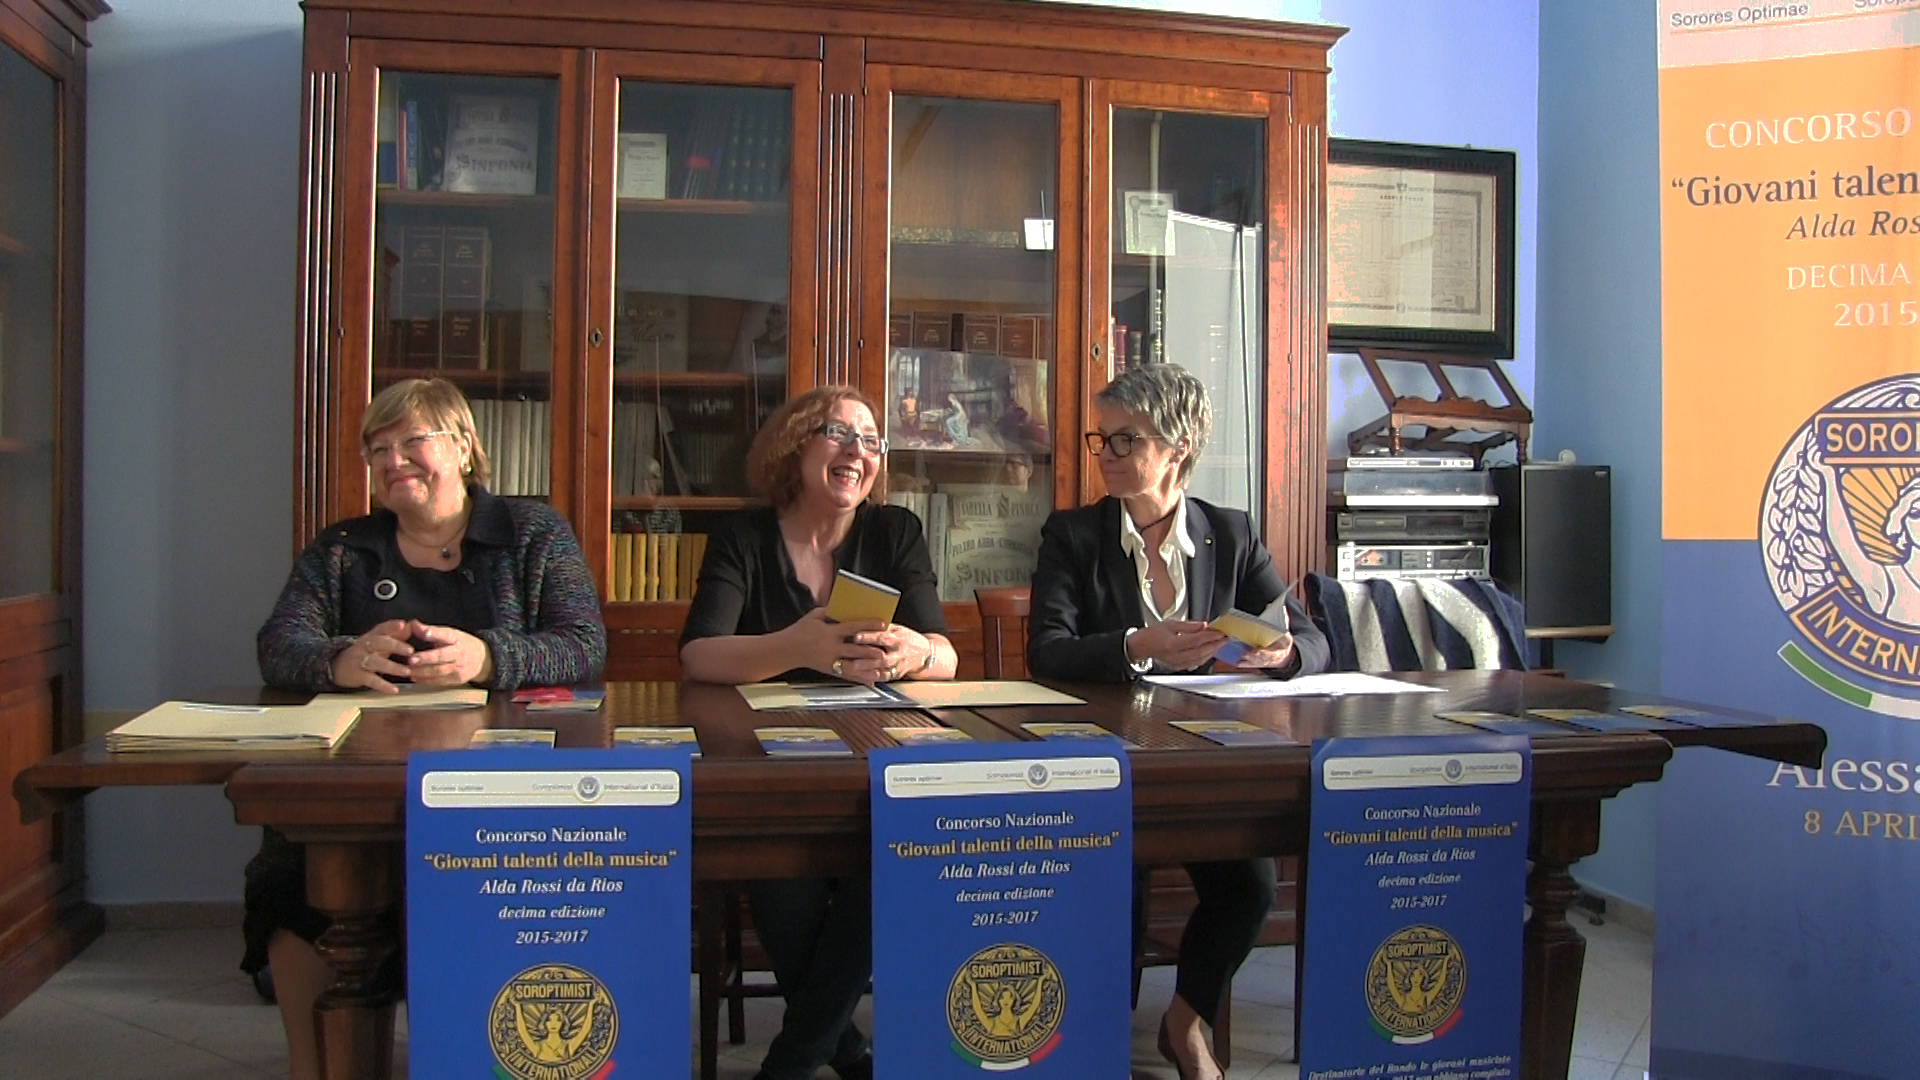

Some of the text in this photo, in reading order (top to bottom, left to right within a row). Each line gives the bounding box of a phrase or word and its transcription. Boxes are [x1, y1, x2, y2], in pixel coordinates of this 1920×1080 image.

[1671, 3, 1810, 27] Sorores Optimae
[1705, 107, 1912, 149] CONCORSO
[1671, 165, 1920, 206] “Giovani talen
[1785, 211, 1920, 241] Alda Ros
[1786, 263, 1912, 290] DECIMA
[1834, 301, 1918, 327] 2015
[1806, 600, 1920, 676] INTERN
[935, 811, 1074, 831] Concorso Nazionale
[1364, 802, 1481, 821] Concorso Nazionale
[1385, 825, 1428, 841] talenti
[1431, 825, 1462, 840] della
[1804, 810, 1920, 840] 8 APRI
[476, 827, 628, 844] Concorso Nazionale
[961, 837, 1011, 855] talenti
[1016, 835, 1053, 851] della
[503, 852, 558, 868] talenti
[563, 851, 604, 867] della
[1364, 847, 1476, 866] Alda Rossi da Rios
[938, 859, 1071, 880] Alda Rossi da Rios
[478, 877, 623, 895] Alda Rossi da Rios
[1378, 873, 1462, 888] decima edizione
[956, 886, 1055, 903] decima edizione
[1390, 894, 1448, 910] 2015-2017
[498, 904, 606, 920] decima edizione
[971, 909, 1040, 927] 2015-2017
[516, 929, 589, 944] 2015-2017
[1387, 940, 1448, 958] SOROPTIMIST
[971, 961, 1042, 979] SOROPTIMIST
[515, 983, 592, 998] SOROPTIMIST
[965, 1023, 1048, 1054] INTERNATIONAL
[509, 1049, 599, 1080] INTERNATIONAL
